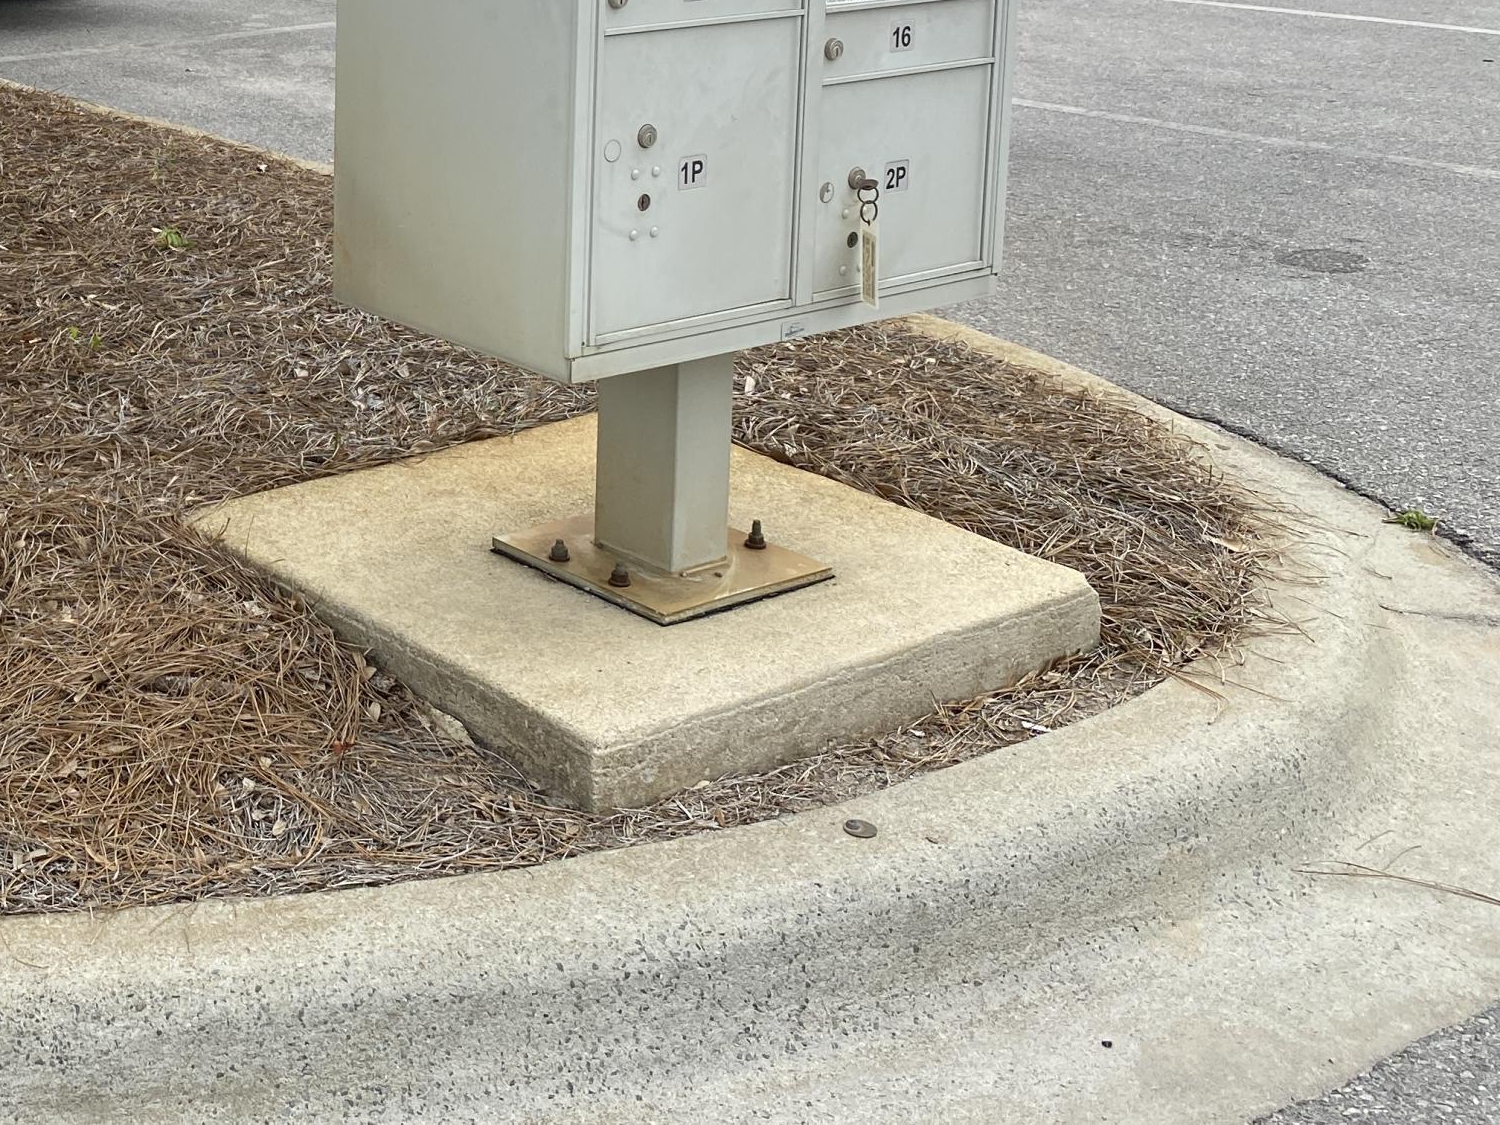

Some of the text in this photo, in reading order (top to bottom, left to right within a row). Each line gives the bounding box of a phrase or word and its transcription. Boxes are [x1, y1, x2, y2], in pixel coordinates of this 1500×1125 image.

[892, 25, 911, 48] 16
[680, 159, 703, 186] 1P
[885, 165, 906, 190] 2P
